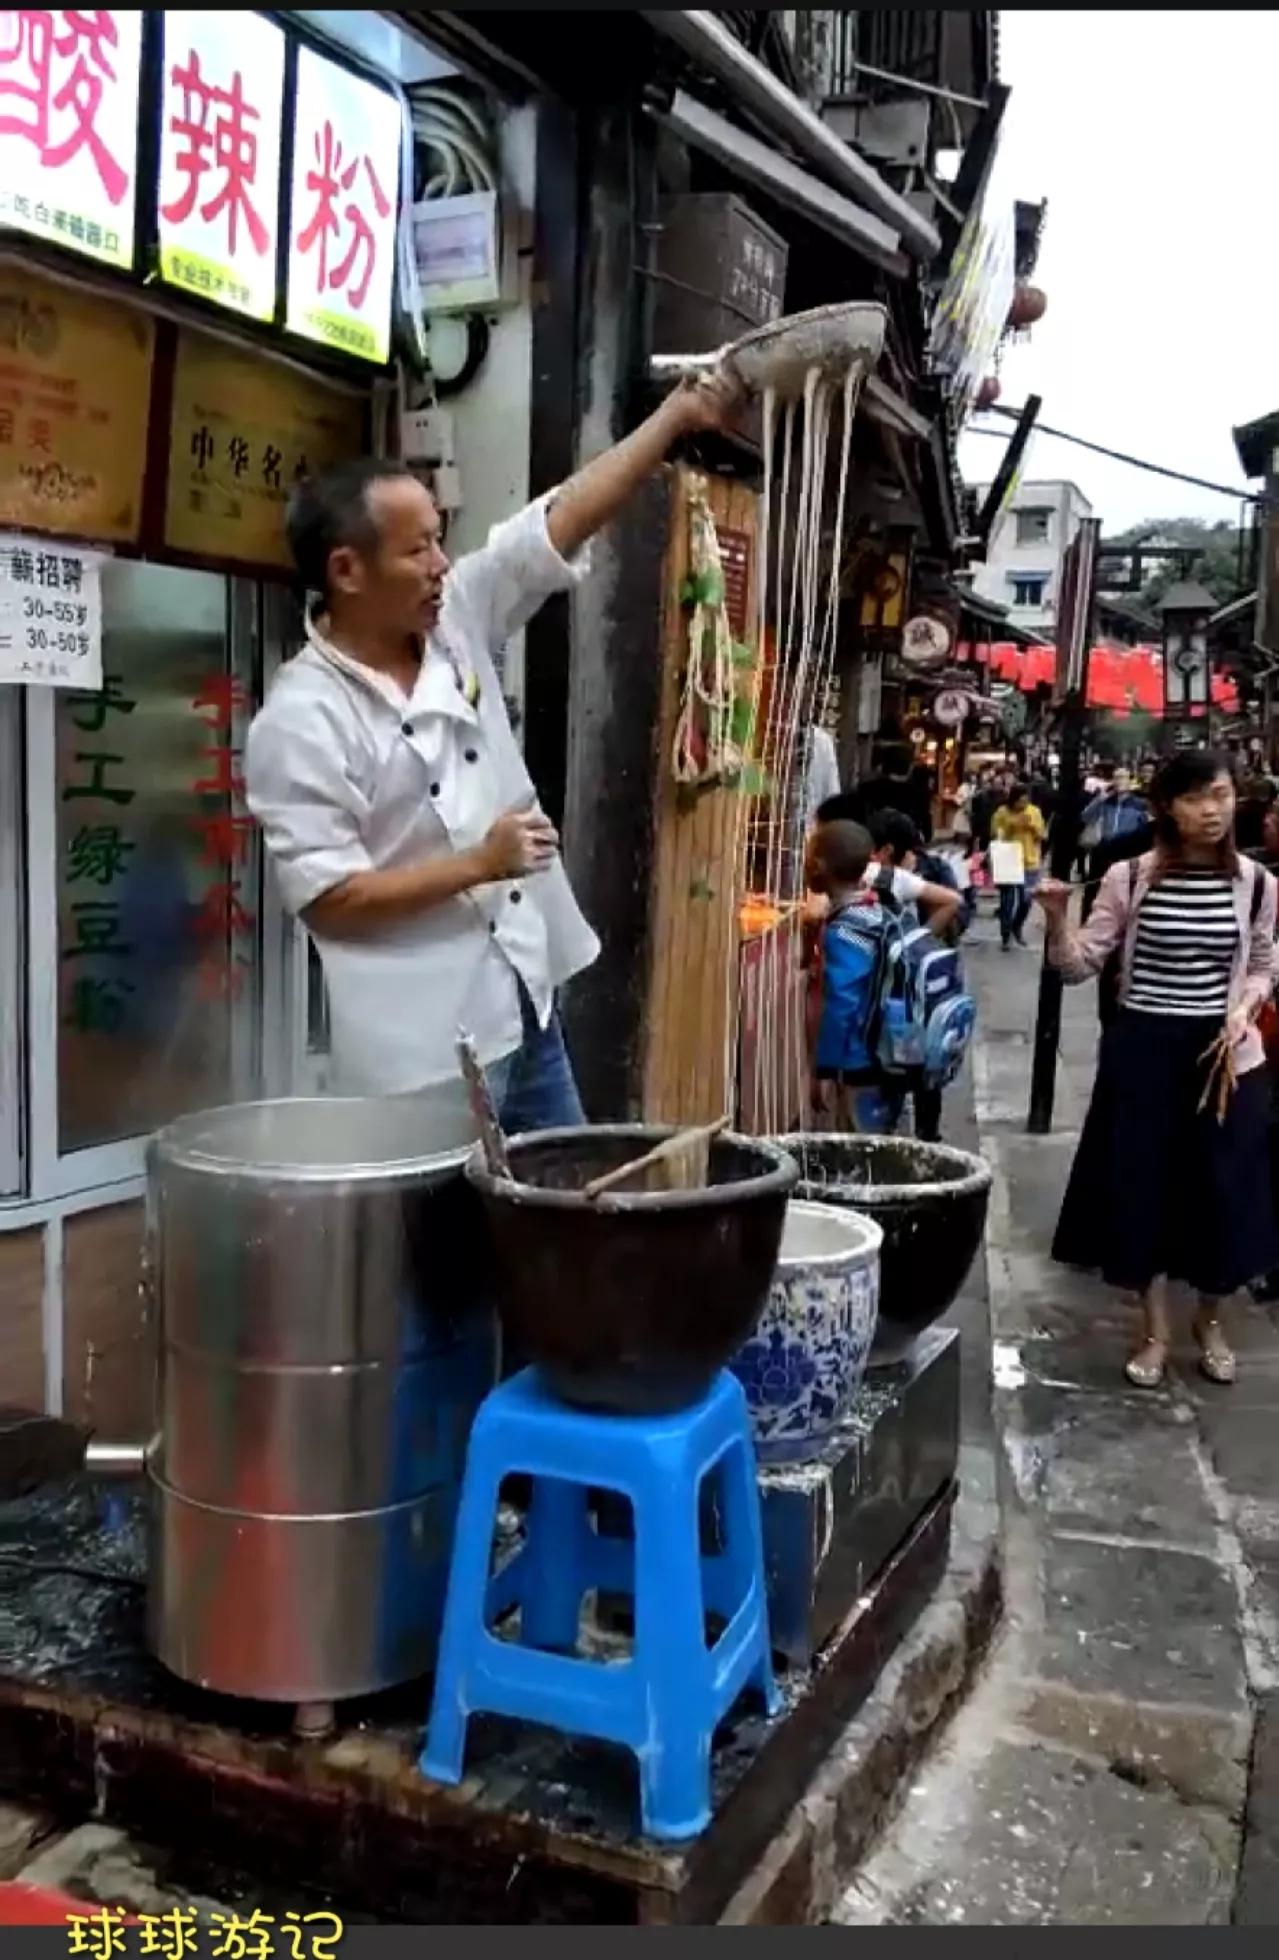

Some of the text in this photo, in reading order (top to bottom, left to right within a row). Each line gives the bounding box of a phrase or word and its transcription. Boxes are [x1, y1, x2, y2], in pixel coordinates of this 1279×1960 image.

[0, 10, 391, 310] 酸辣粉
[191, 426, 330, 488] 中华名小
[26, 626, 90, 657] 30-50岁
[62, 676, 136, 1033] 手工绿豆粉
